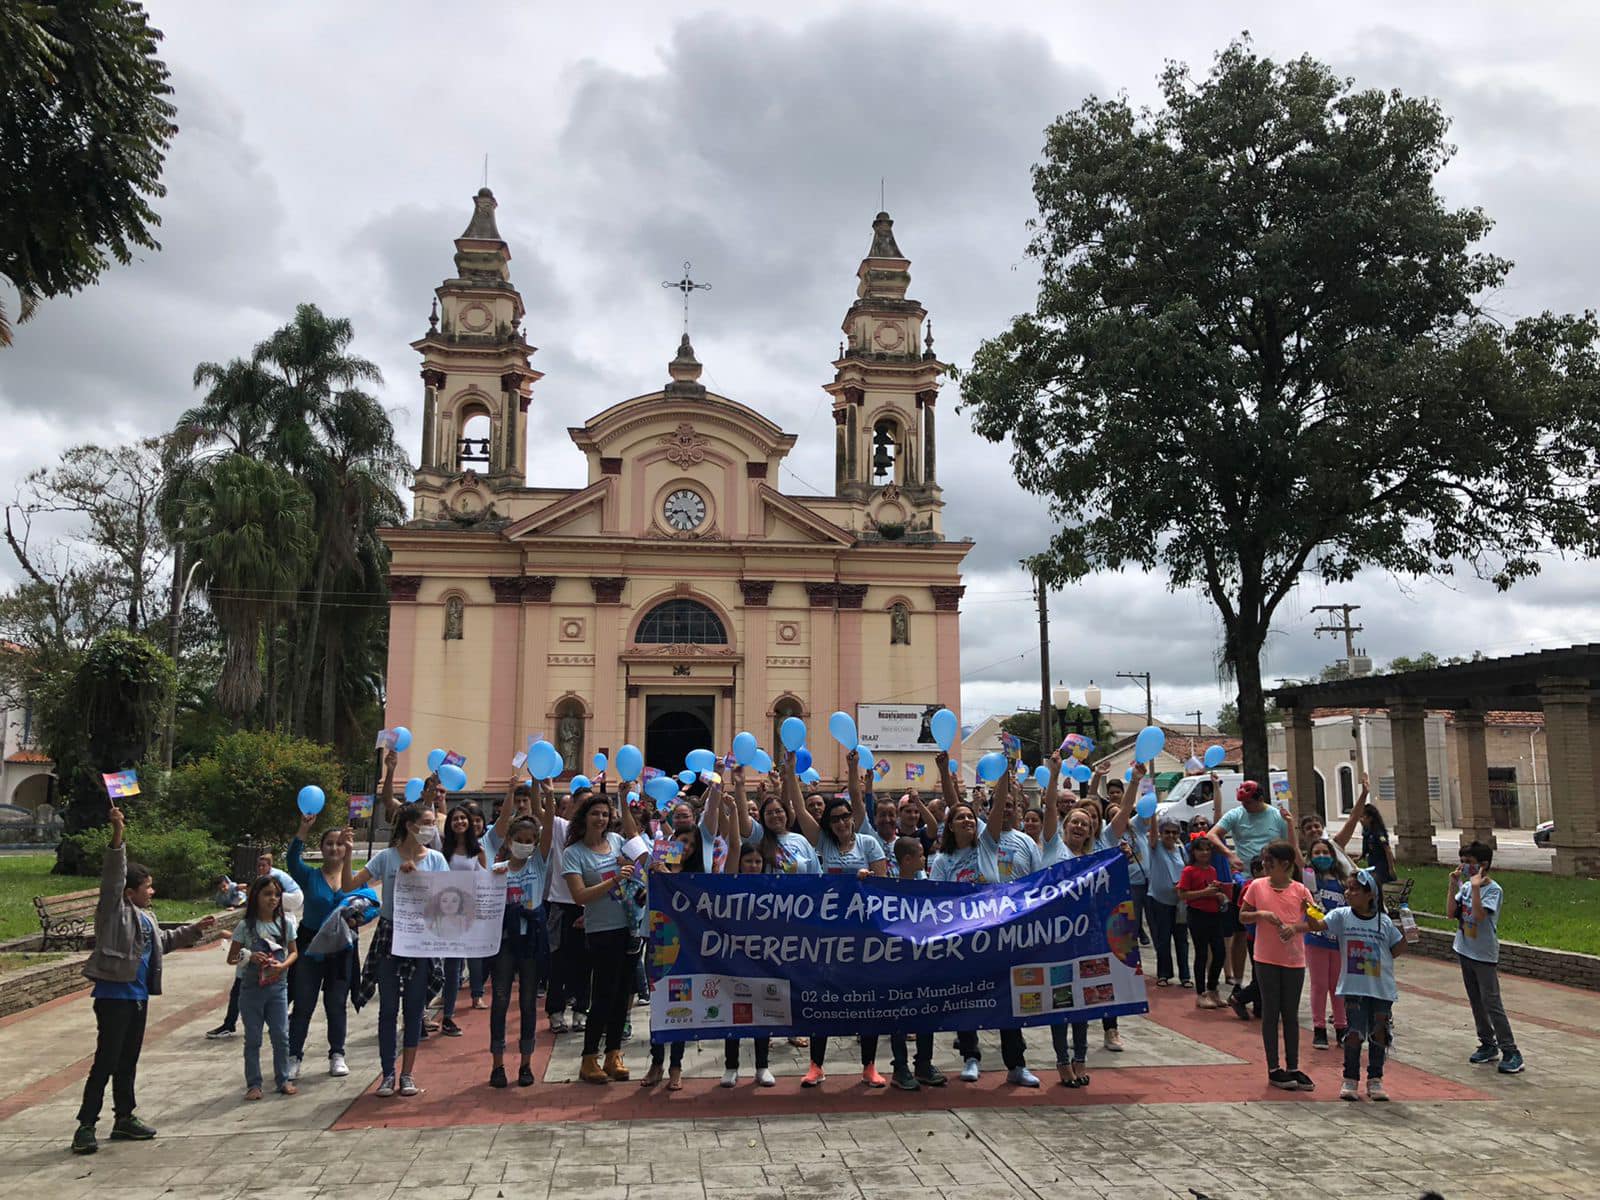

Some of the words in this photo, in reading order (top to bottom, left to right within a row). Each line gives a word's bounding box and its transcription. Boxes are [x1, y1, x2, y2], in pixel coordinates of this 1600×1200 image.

[671, 890, 690, 912] O
[696, 892, 815, 922] AUTISMO
[820, 888, 840, 920] É
[844, 892, 954, 925] APENAS
[960, 895, 1017, 921] UMA
[1023, 866, 1111, 909] FORMA
[700, 930, 855, 966] DIFERENTE
[862, 936, 903, 963] DE
[910, 933, 965, 960] VER
[971, 930, 991, 953] O
[998, 914, 1090, 952] MUNDO
[801, 990, 818, 1002] 02
[821, 990, 840, 1003] de
[842, 990, 876, 1003] abril
[888, 989, 913, 1001] Dia
[917, 981, 974, 999] Mundial
[977, 980, 995, 992] da
[802, 1006, 918, 1019] Conscientização
[920, 1003, 938, 1014] do
[942, 998, 997, 1012] Autismo
